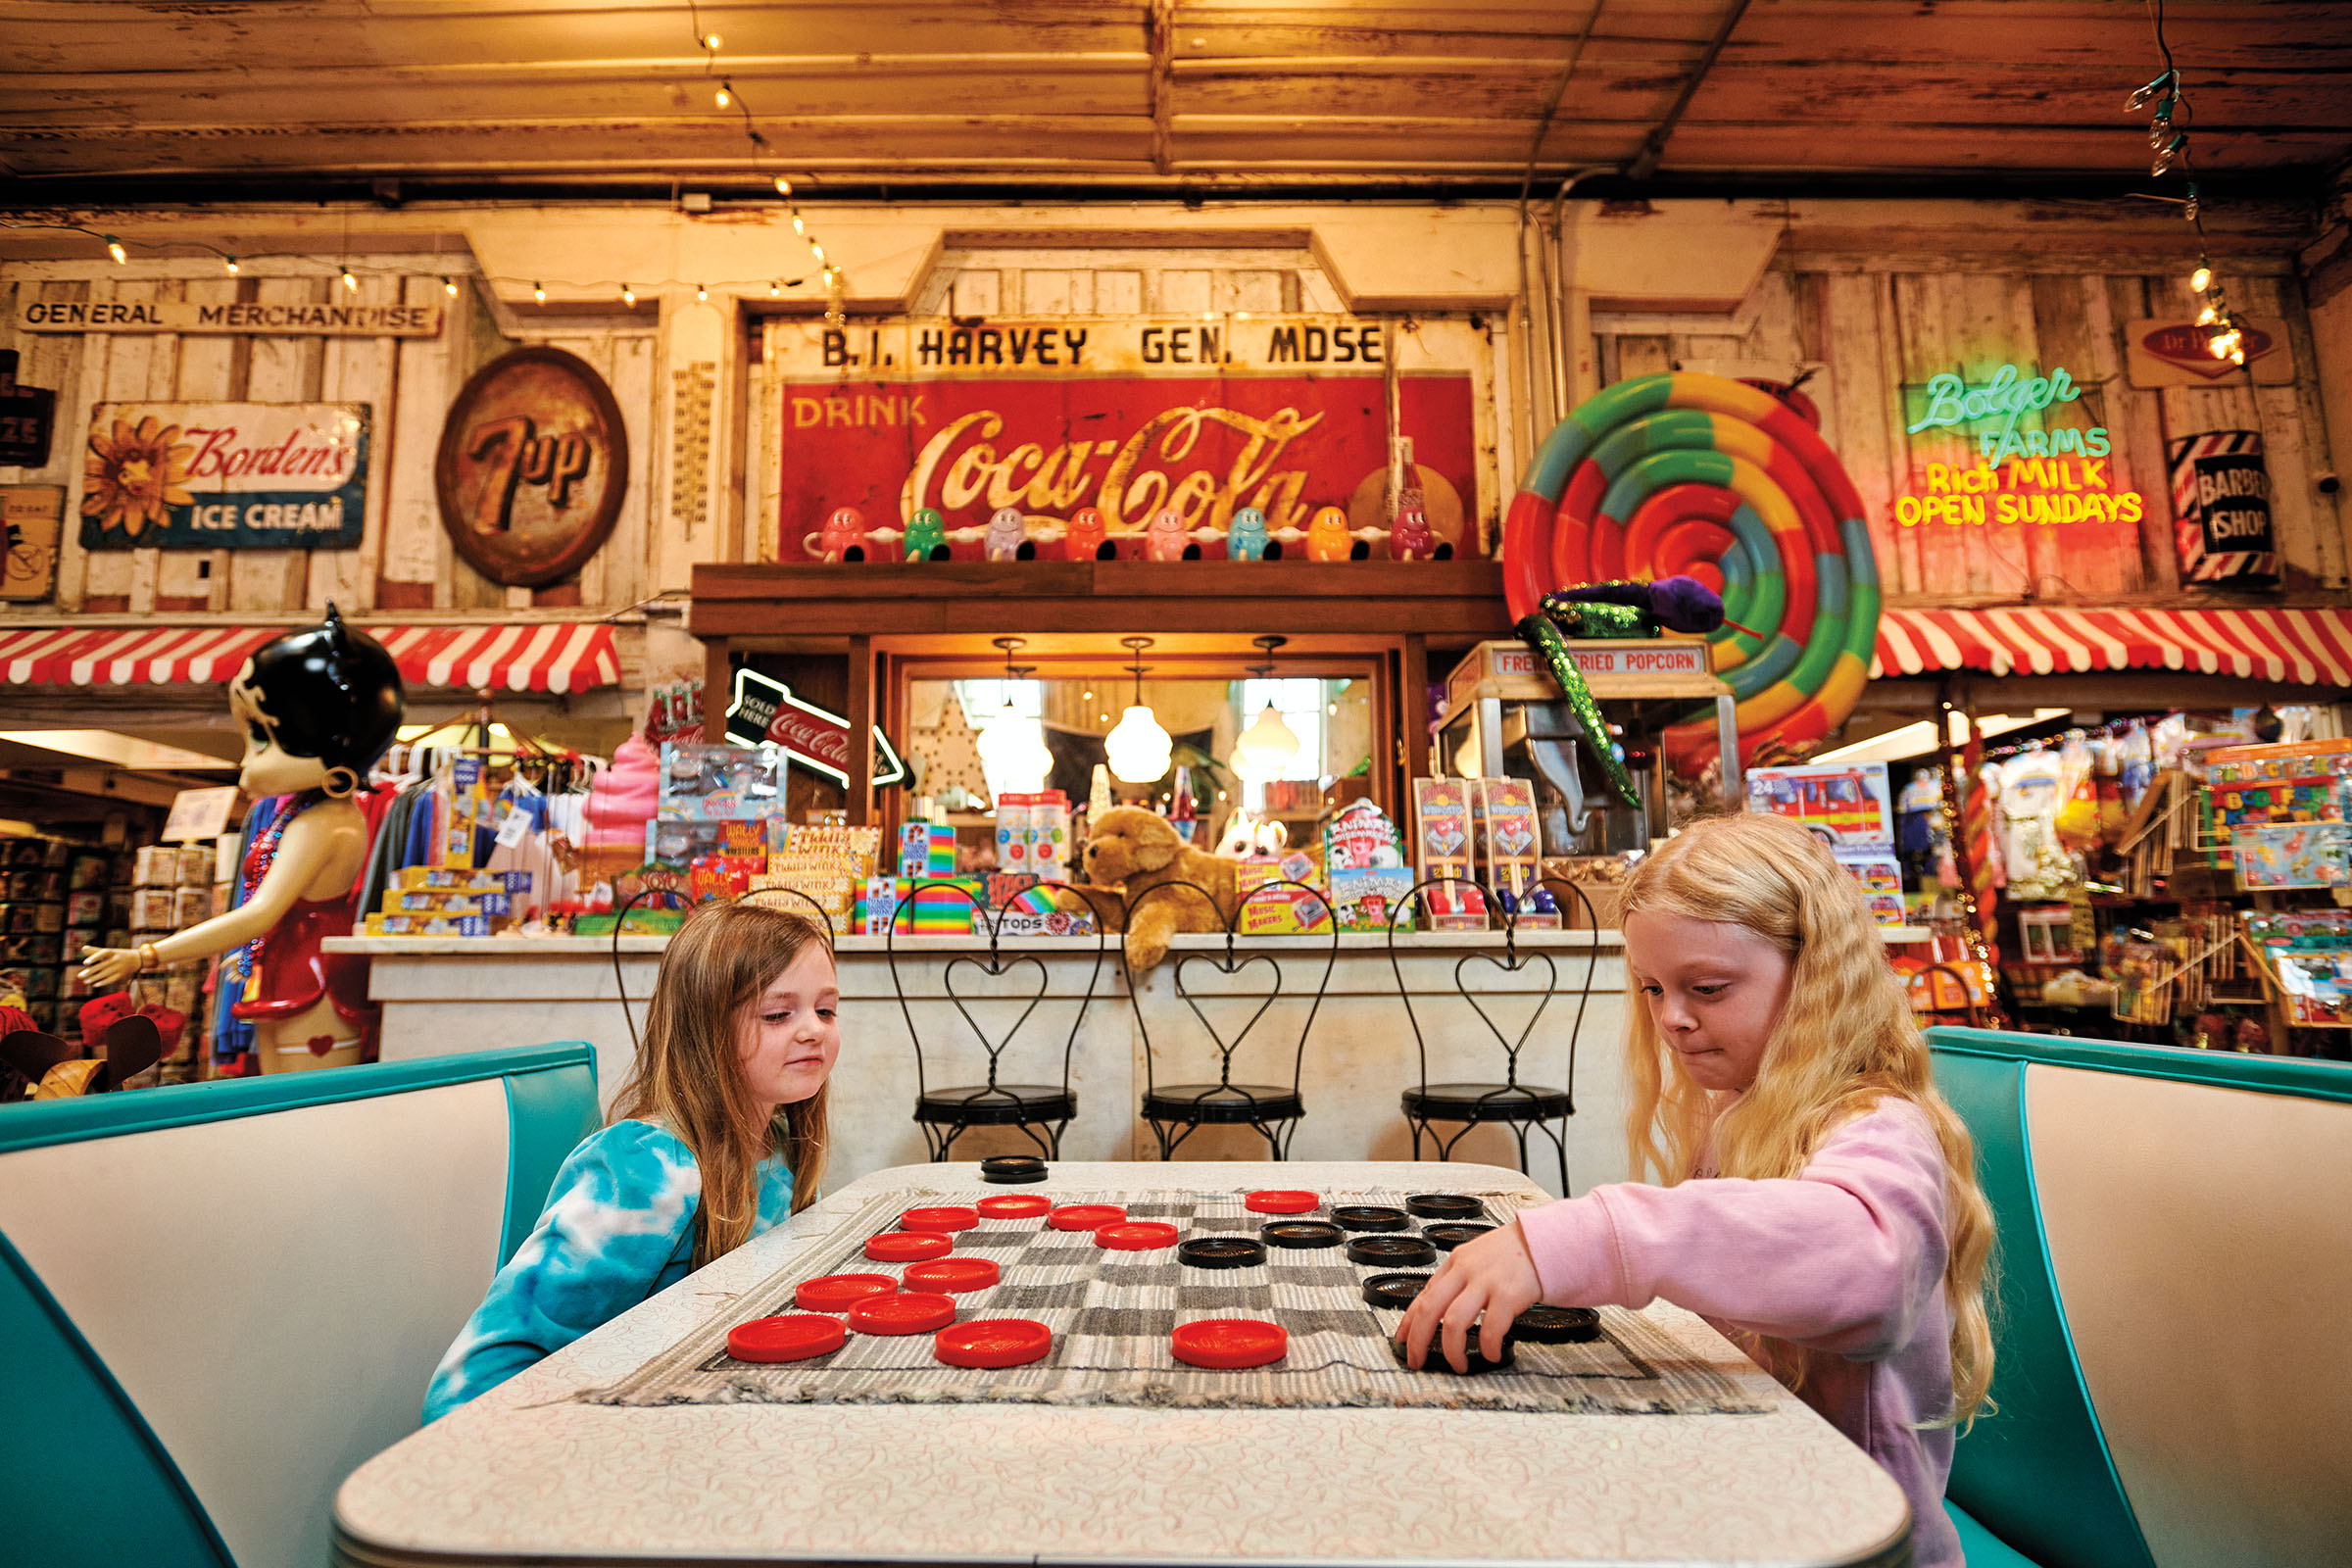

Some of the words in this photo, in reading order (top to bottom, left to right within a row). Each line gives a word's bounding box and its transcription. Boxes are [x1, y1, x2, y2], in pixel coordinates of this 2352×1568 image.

[26, 304, 163, 324] GENERAL
[918, 328, 1088, 365] HARVEY
[1142, 327, 1232, 364] GEN.
[1268, 326, 1382, 363] MDSE
[791, 394, 927, 428] DRINK
[184, 426, 353, 479] Borden's
[1980, 427, 2111, 460] FARMS
[900, 406, 1325, 531] Coca-Cola
[2008, 459, 2109, 492] MILK
[2198, 468, 2272, 507] BARBE
[190, 504, 239, 530] ICE
[245, 501, 343, 532] CREAM
[1895, 495, 1986, 527] OPEN
[1994, 492, 2143, 525] SUNDAYS
[1626, 654, 1695, 670] POPCORN
[737, 707, 770, 729] HERE
[743, 693, 777, 716] SOLD
[1752, 781, 1774, 796] 24
